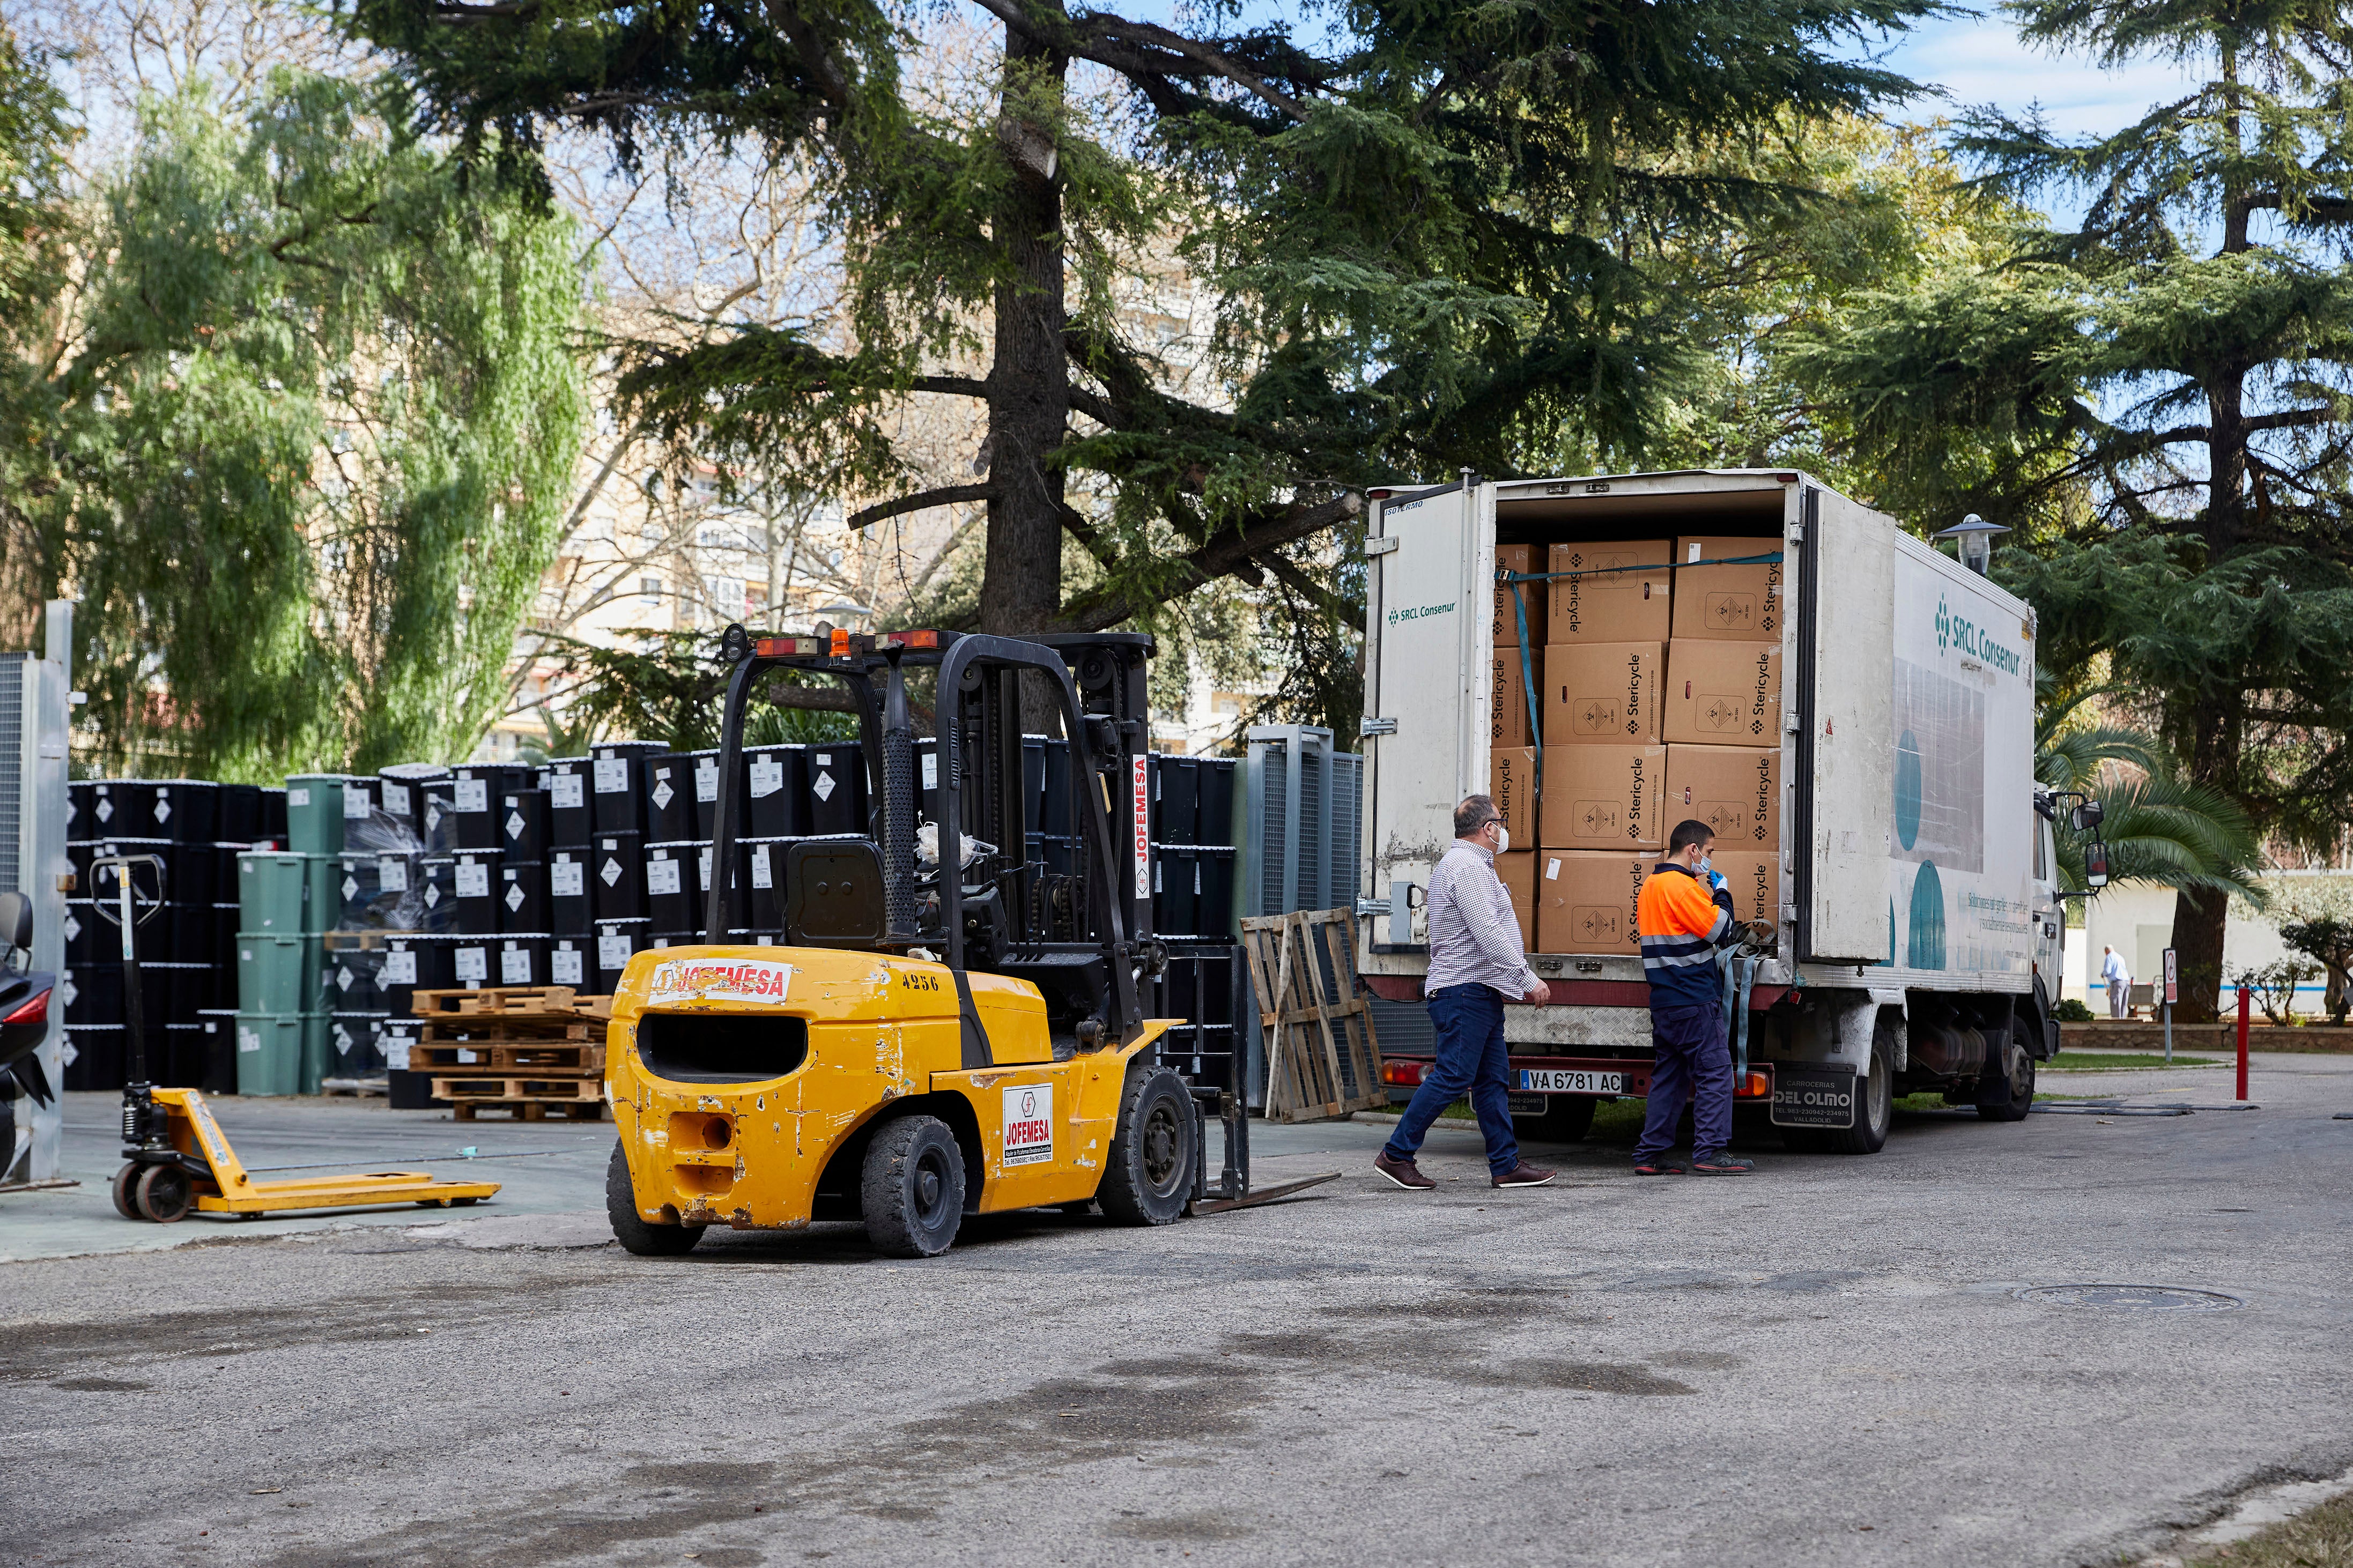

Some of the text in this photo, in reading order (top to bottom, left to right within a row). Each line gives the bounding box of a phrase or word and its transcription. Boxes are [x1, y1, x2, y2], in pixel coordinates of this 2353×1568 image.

[1385, 501, 1423, 516] ISOTERMO
[1401, 602, 1455, 621] SRCL Consenur
[1494, 557, 1506, 617] Stericle
[1567, 572, 1581, 631] Stericycle
[1953, 615, 1977, 656] SRCL
[1979, 628, 2019, 677] Consenur
[1492, 660, 1506, 719] Stericycle
[1627, 655, 1642, 716] Stericycle
[1753, 653, 1770, 716] Stericycle
[1135, 759, 1148, 863] JOFEMESA
[1499, 759, 1513, 820] Stericycle
[1629, 758, 1645, 820] Stericycle
[1755, 759, 1772, 821] Stericycle
[1630, 863, 1643, 925] Stericycle
[1752, 865, 1768, 928] Stericycle
[903, 974, 939, 991] 4256
[1530, 1072, 1621, 1091] VA 6781 AC
[1775, 1090, 1851, 1107] DEL OLMO
[1787, 1080, 1836, 1088] CARROCERIAS
[1007, 1119, 1049, 1146] JOFEMESA
